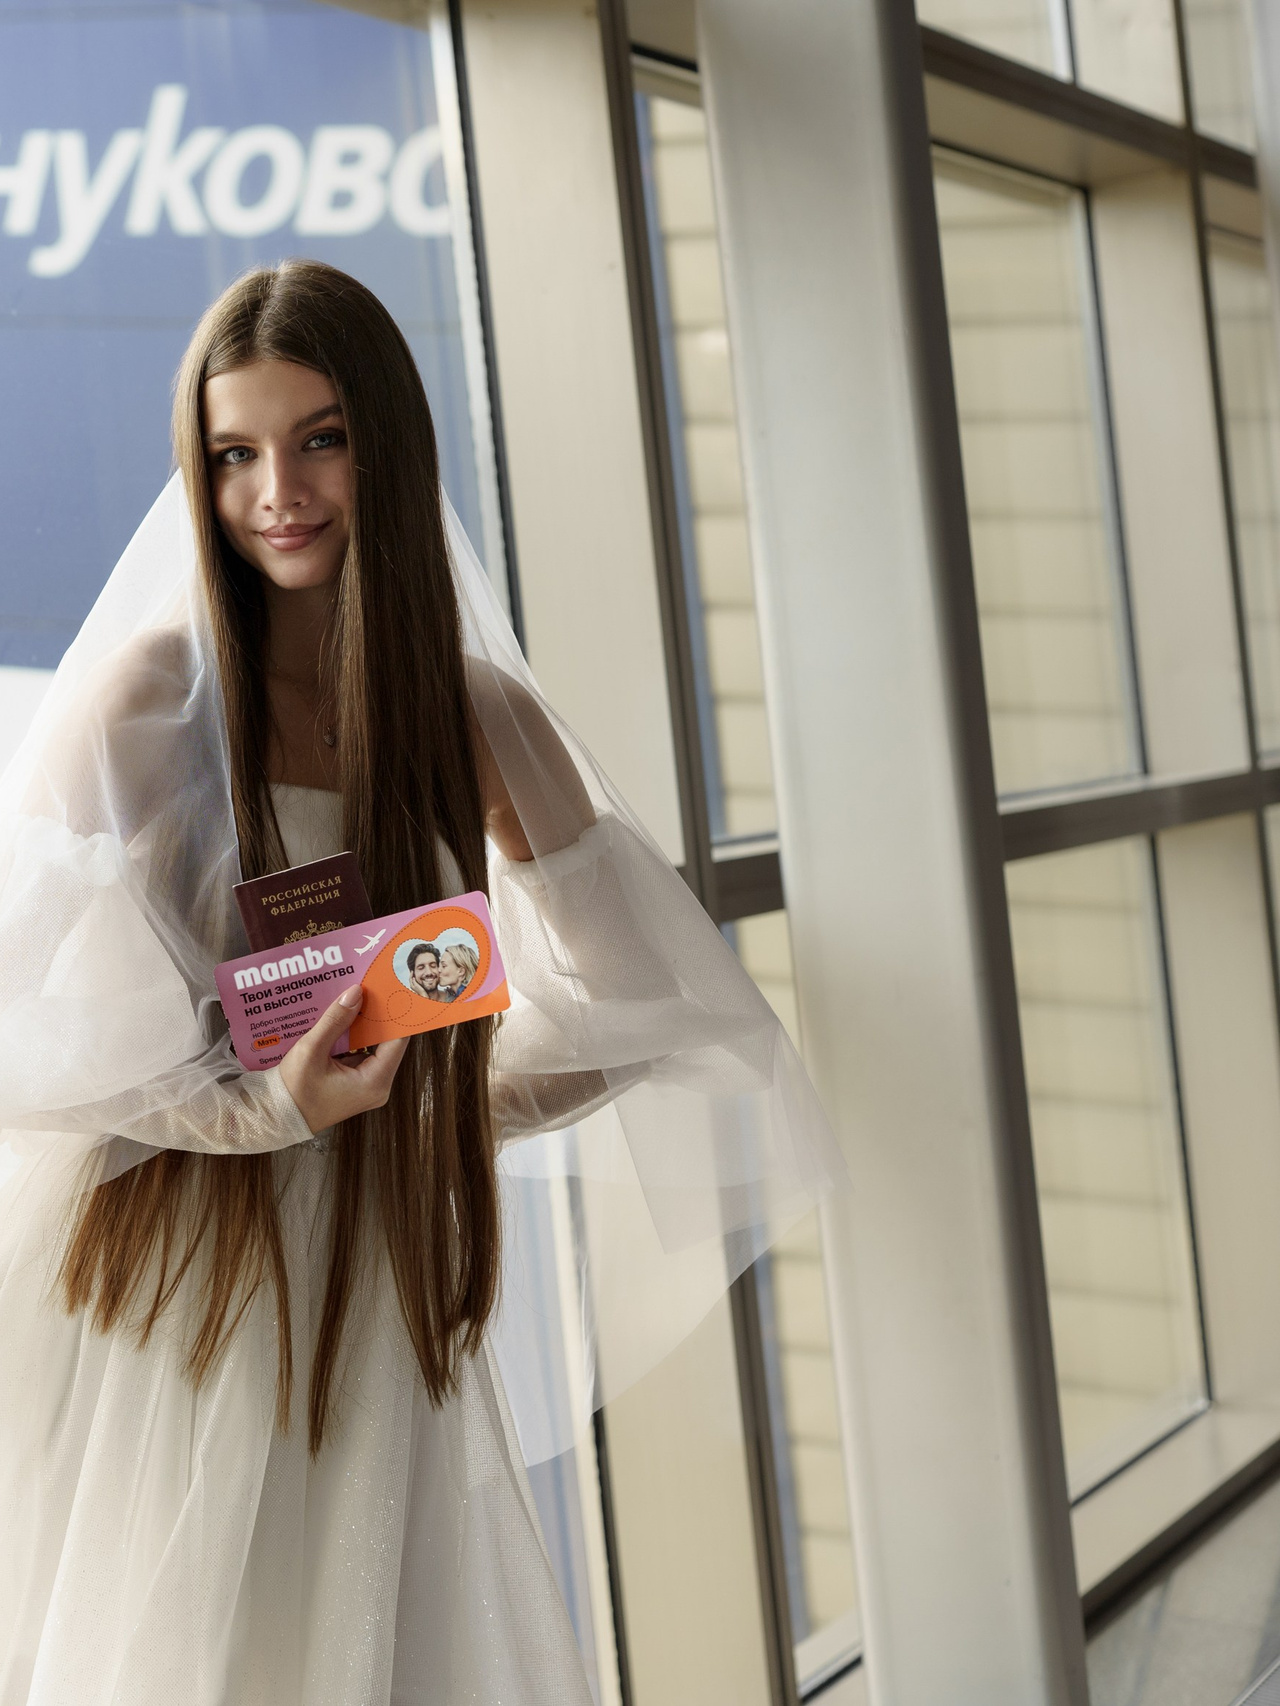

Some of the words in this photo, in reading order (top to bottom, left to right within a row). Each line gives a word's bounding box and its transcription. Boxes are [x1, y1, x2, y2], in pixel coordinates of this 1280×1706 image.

[261, 875, 342, 906] РОССИЙСКАЯ
[270, 889, 340, 916] ФЕДЕРАЦИЯ
[233, 945, 344, 990] mamba
[240, 988, 273, 1004] Твои
[275, 965, 355, 995] знакомства
[244, 1006, 262, 1017] на
[264, 990, 313, 1012] высоте
[250, 1019, 274, 1031] Добро
[274, 1006, 319, 1022] пожаловать
[262, 1027, 281, 1036] рейс
[281, 1018, 309, 1031] Москва
[257, 1037, 278, 1048] Мэтч
[259, 1054, 283, 1065] Speed
